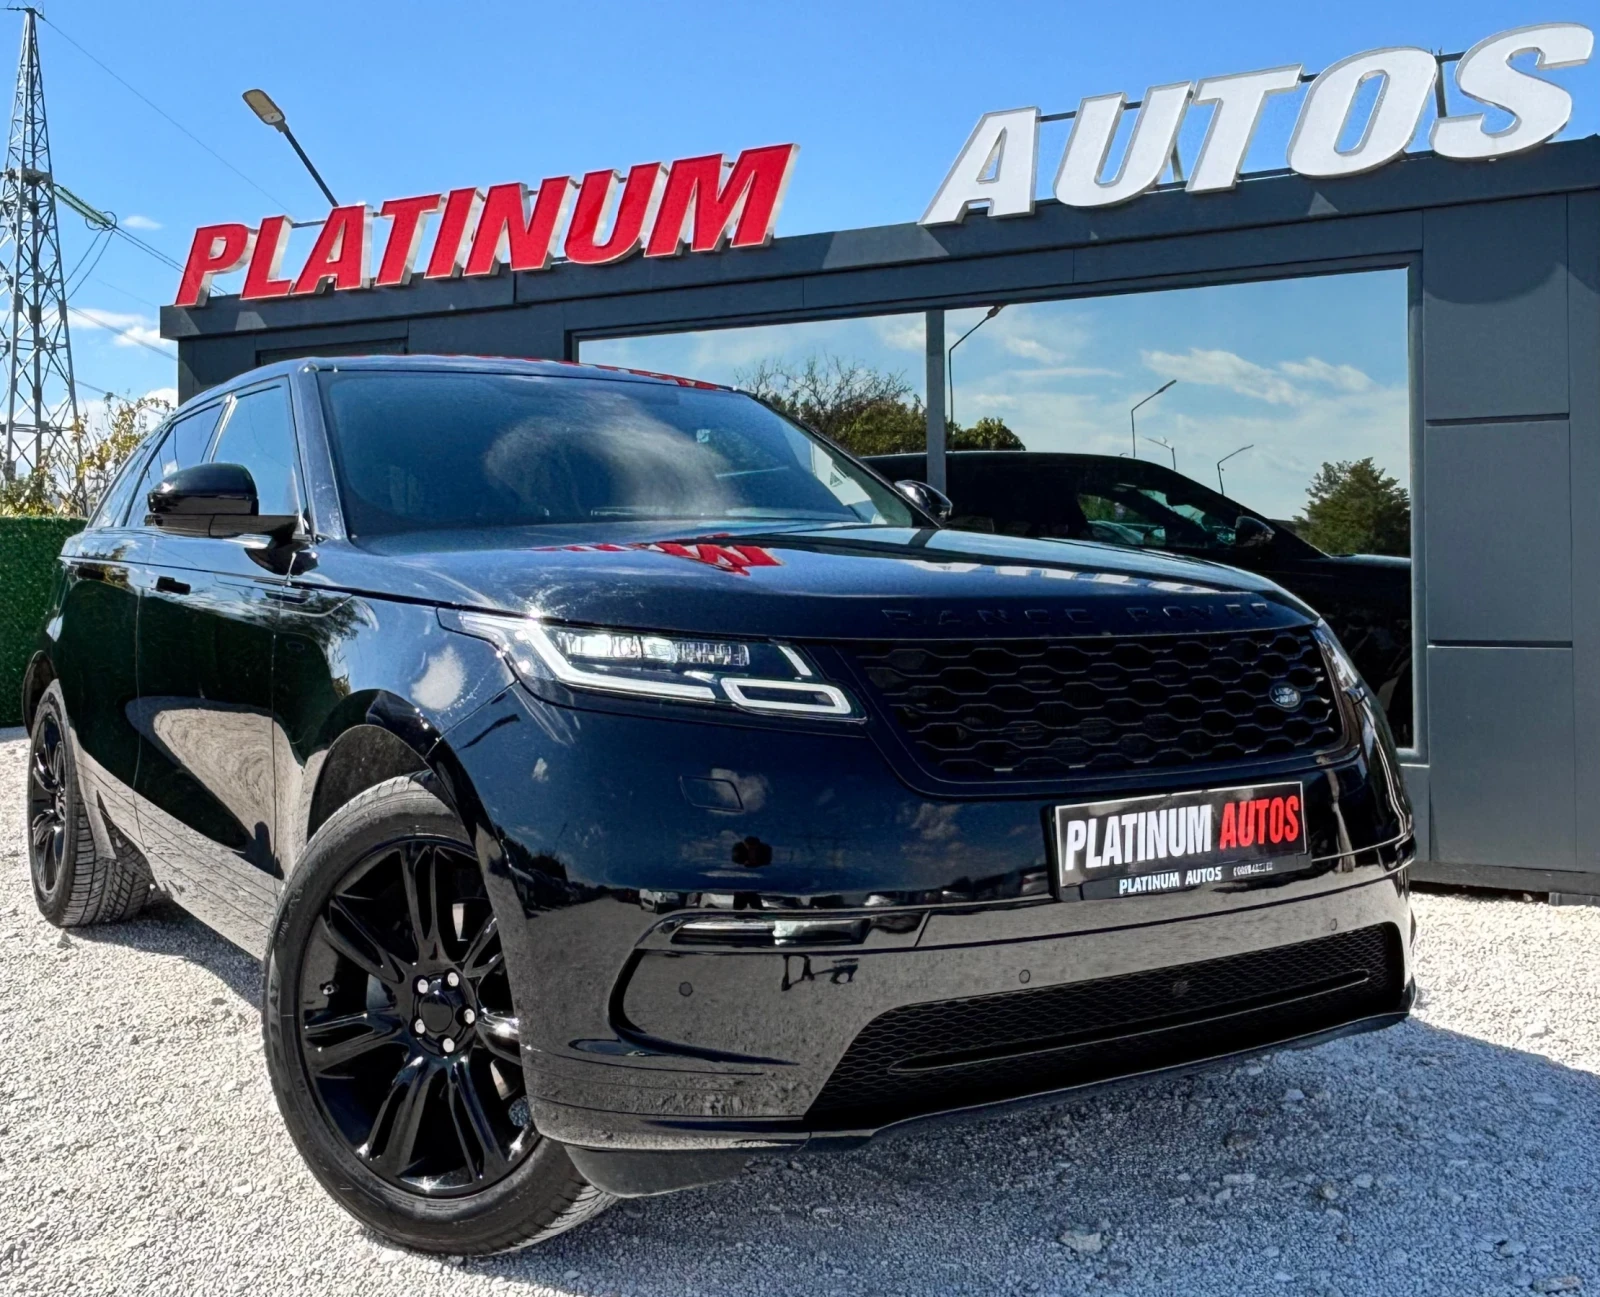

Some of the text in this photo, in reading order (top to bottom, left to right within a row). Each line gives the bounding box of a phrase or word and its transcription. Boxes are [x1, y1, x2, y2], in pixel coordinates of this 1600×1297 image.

[175, 22, 1594, 307] PLATINUM AUTOS
[1065, 795, 1299, 871] PLATINUM AUTOS
[1119, 872, 1180, 895] PLATINUM
[1185, 866, 1222, 885] AUTOS
